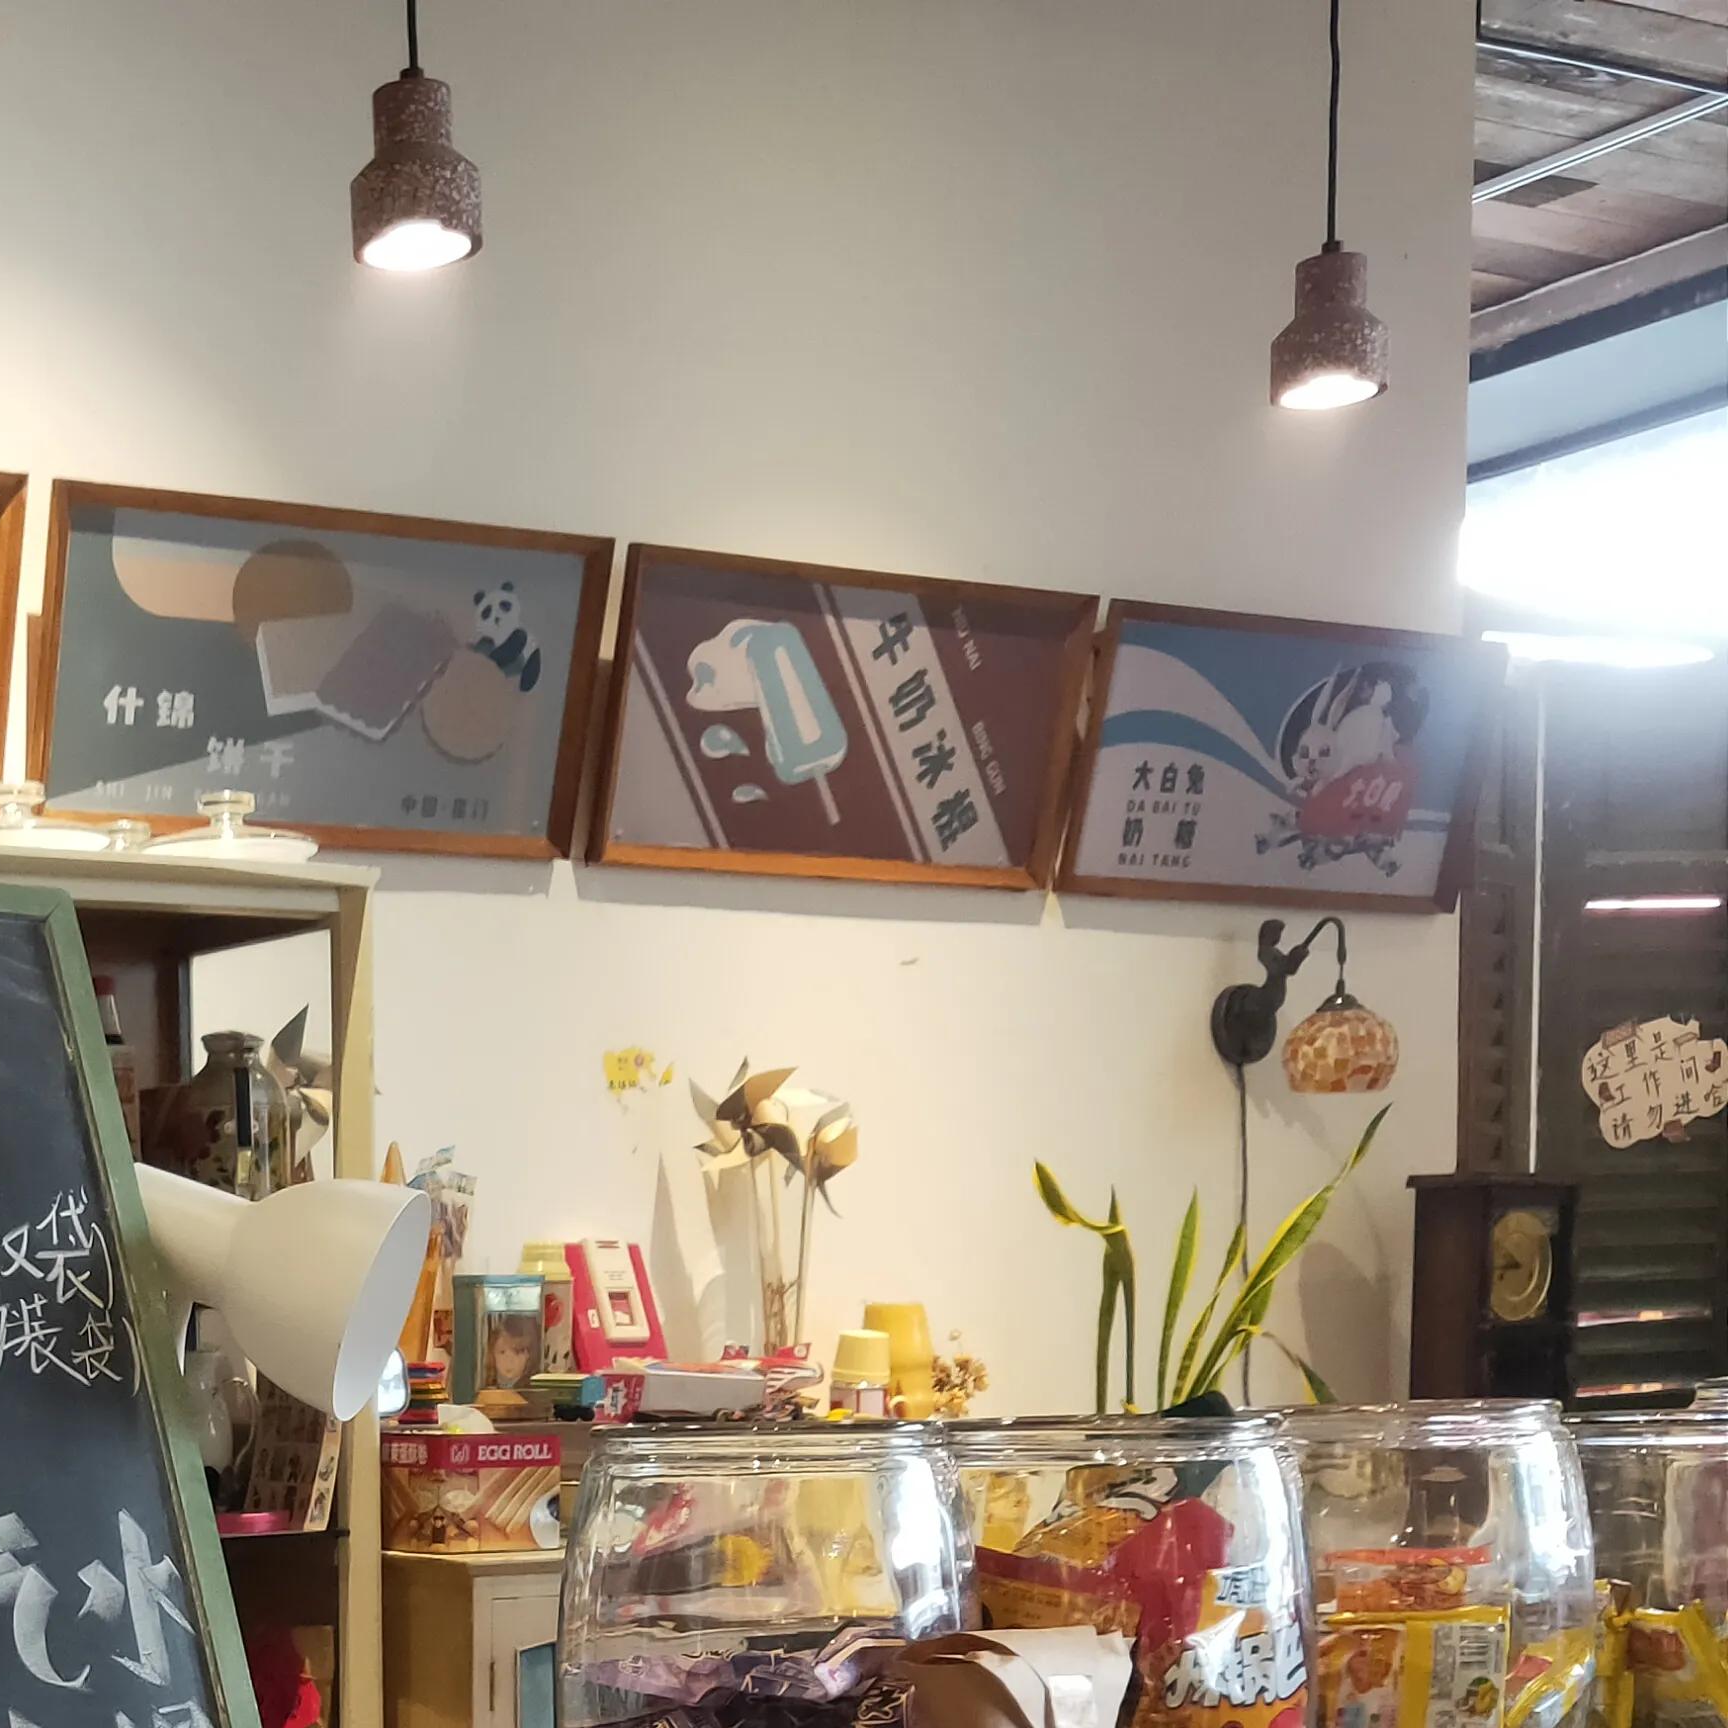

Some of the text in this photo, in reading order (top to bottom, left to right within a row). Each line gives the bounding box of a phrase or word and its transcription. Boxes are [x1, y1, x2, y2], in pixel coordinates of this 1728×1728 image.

[872, 611, 979, 852] 牛奶冰棍
[1132, 760, 1205, 795] 大白兔
[1587, 1031, 1674, 1082] 这里是
[1603, 1056, 1700, 1112] 工作间
[477, 1444, 511, 1461] EGG
[513, 1443, 552, 1460] ROLL
